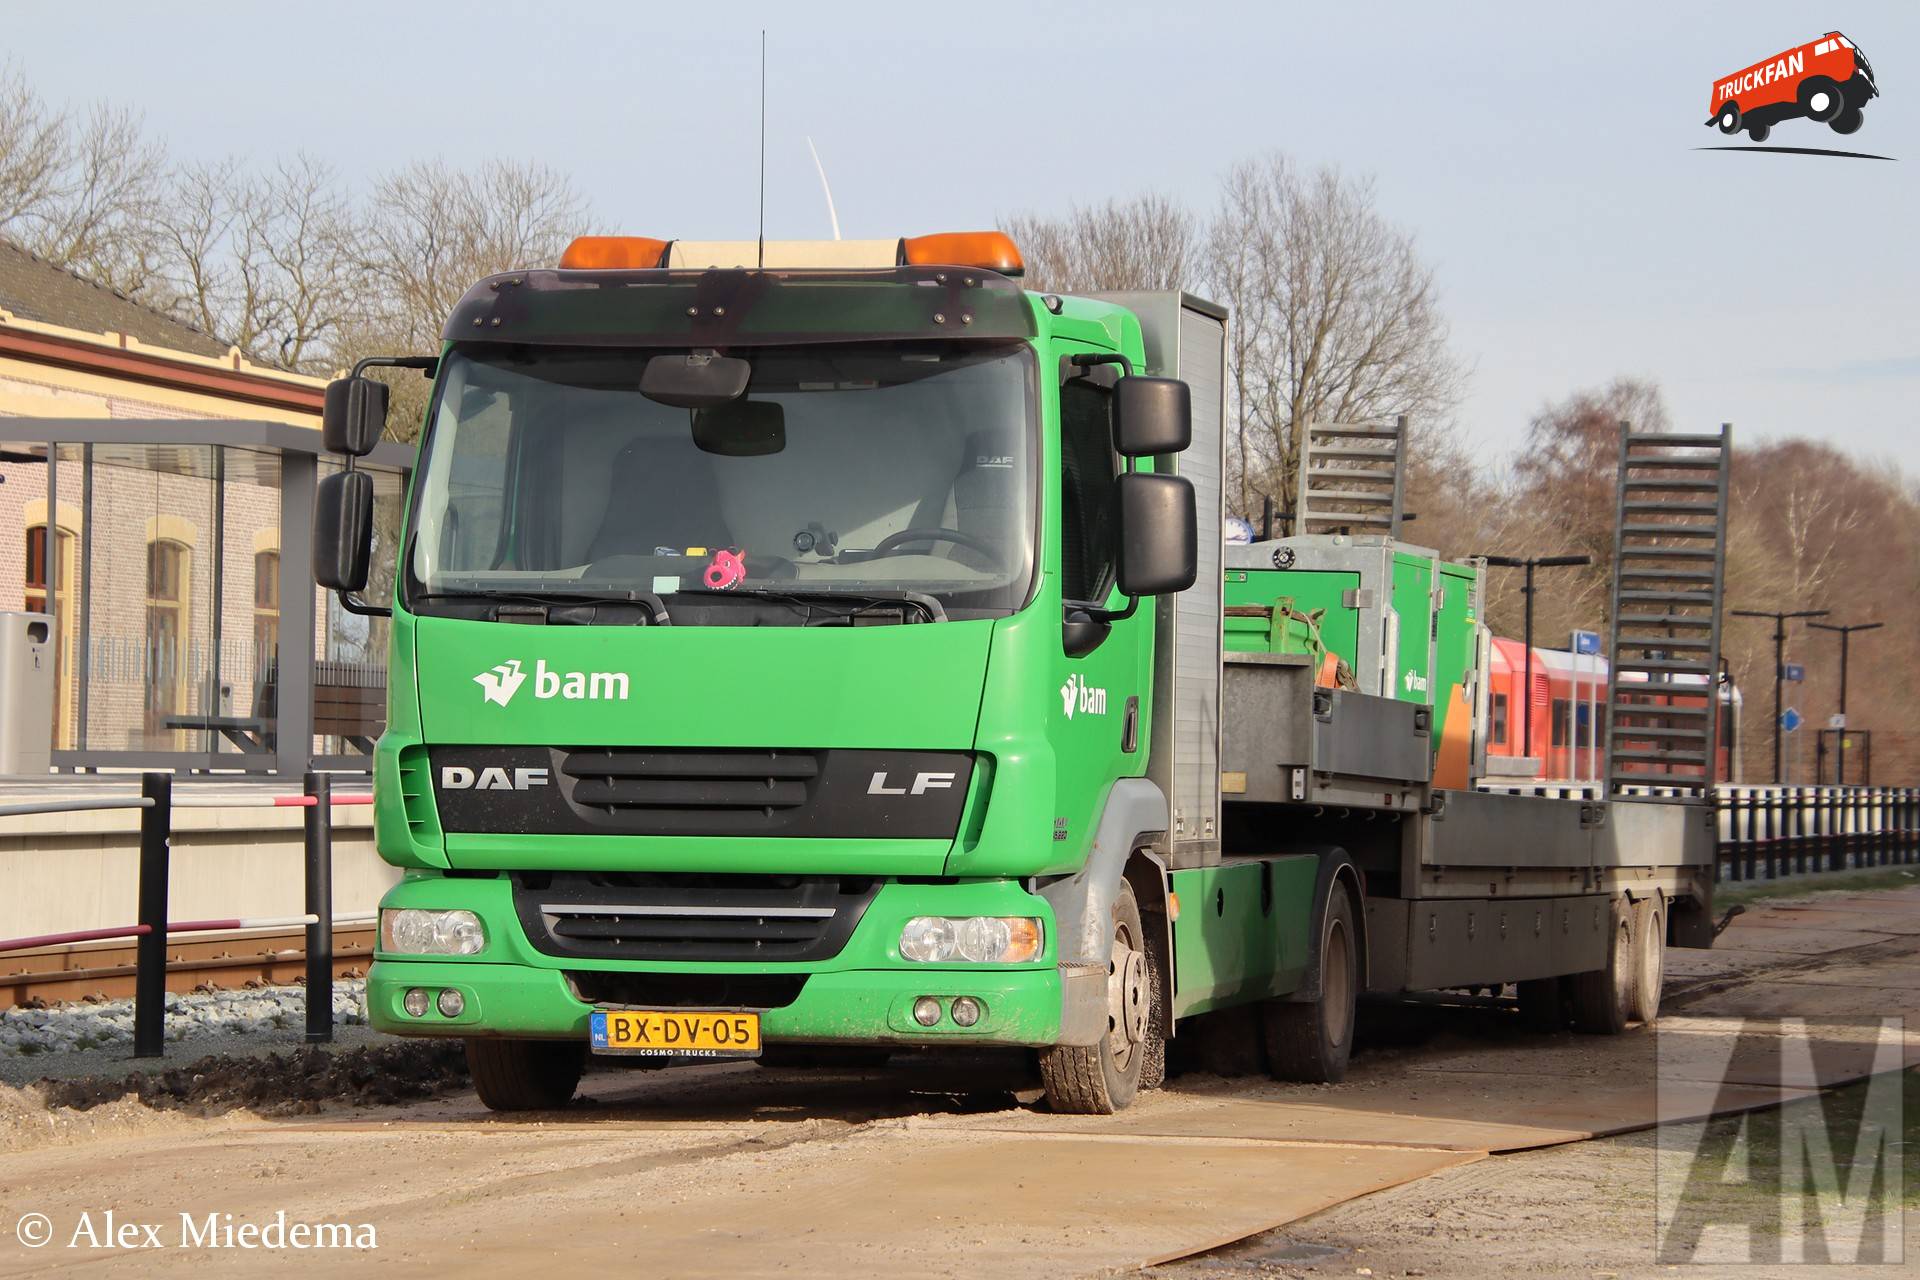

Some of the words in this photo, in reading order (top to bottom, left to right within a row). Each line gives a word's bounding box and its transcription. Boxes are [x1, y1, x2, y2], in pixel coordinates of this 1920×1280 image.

[535, 659, 629, 700] bam
[1080, 674, 1106, 715] bam
[442, 766, 549, 790] DAF
[867, 772, 956, 795] LF
[595, 1033, 606, 1041] NL
[614, 1018, 750, 1044] BX-DV-05
